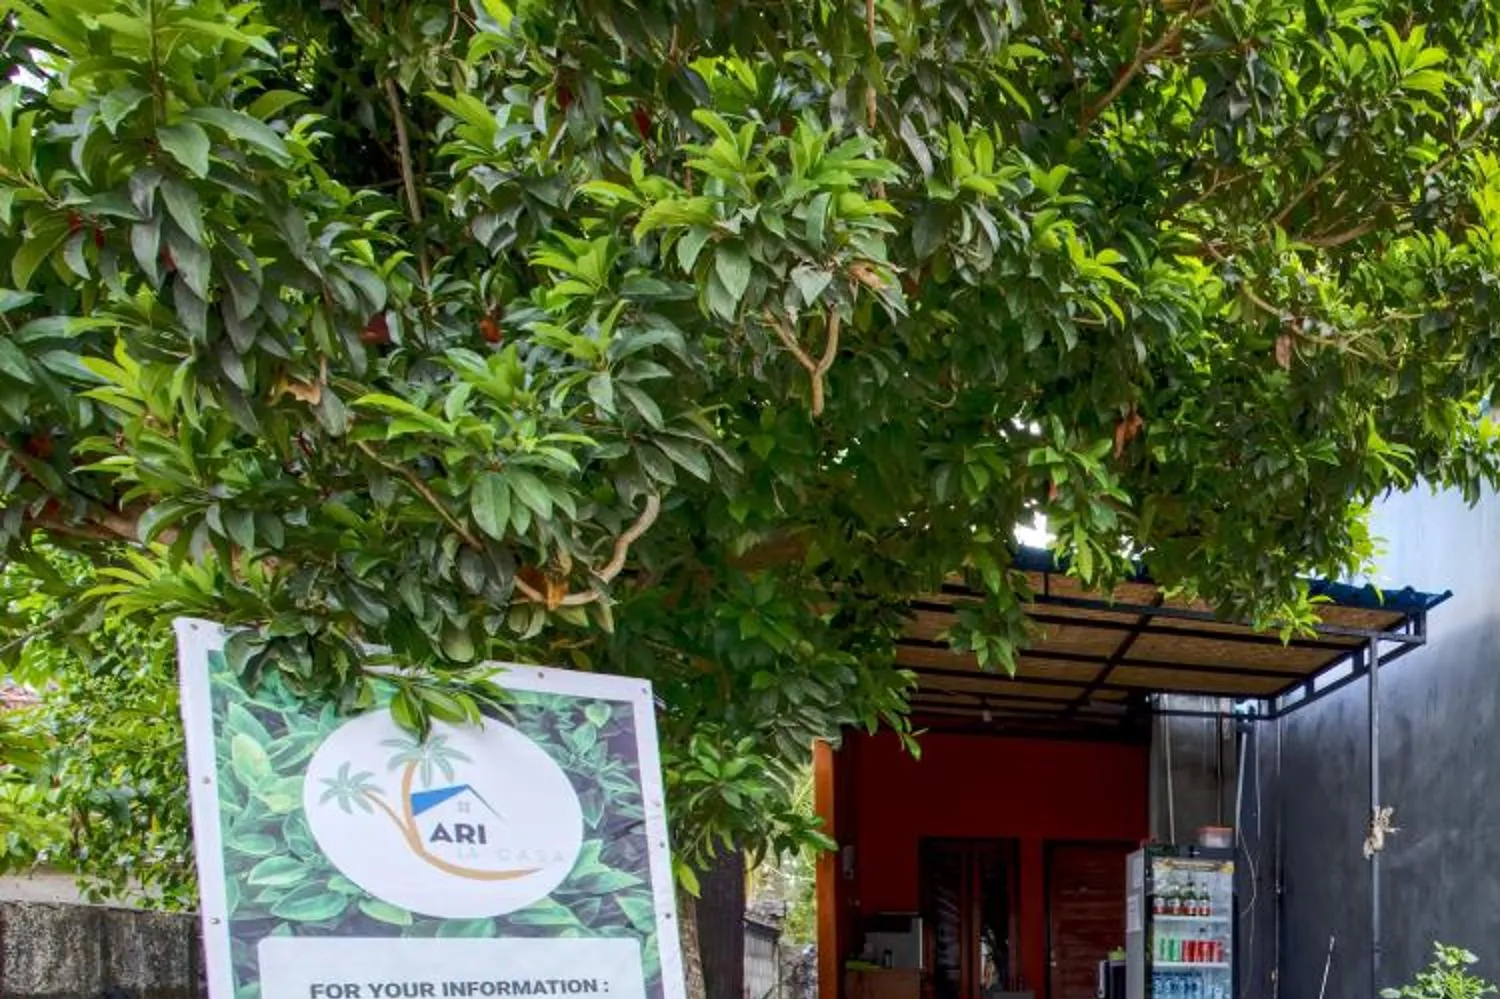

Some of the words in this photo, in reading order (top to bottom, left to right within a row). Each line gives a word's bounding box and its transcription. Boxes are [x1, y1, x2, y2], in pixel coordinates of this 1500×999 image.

[429, 821, 487, 844] ARI
[309, 983, 360, 999] FOR
[367, 981, 435, 998] YOUR
[441, 978, 598, 996] INFORMATION
